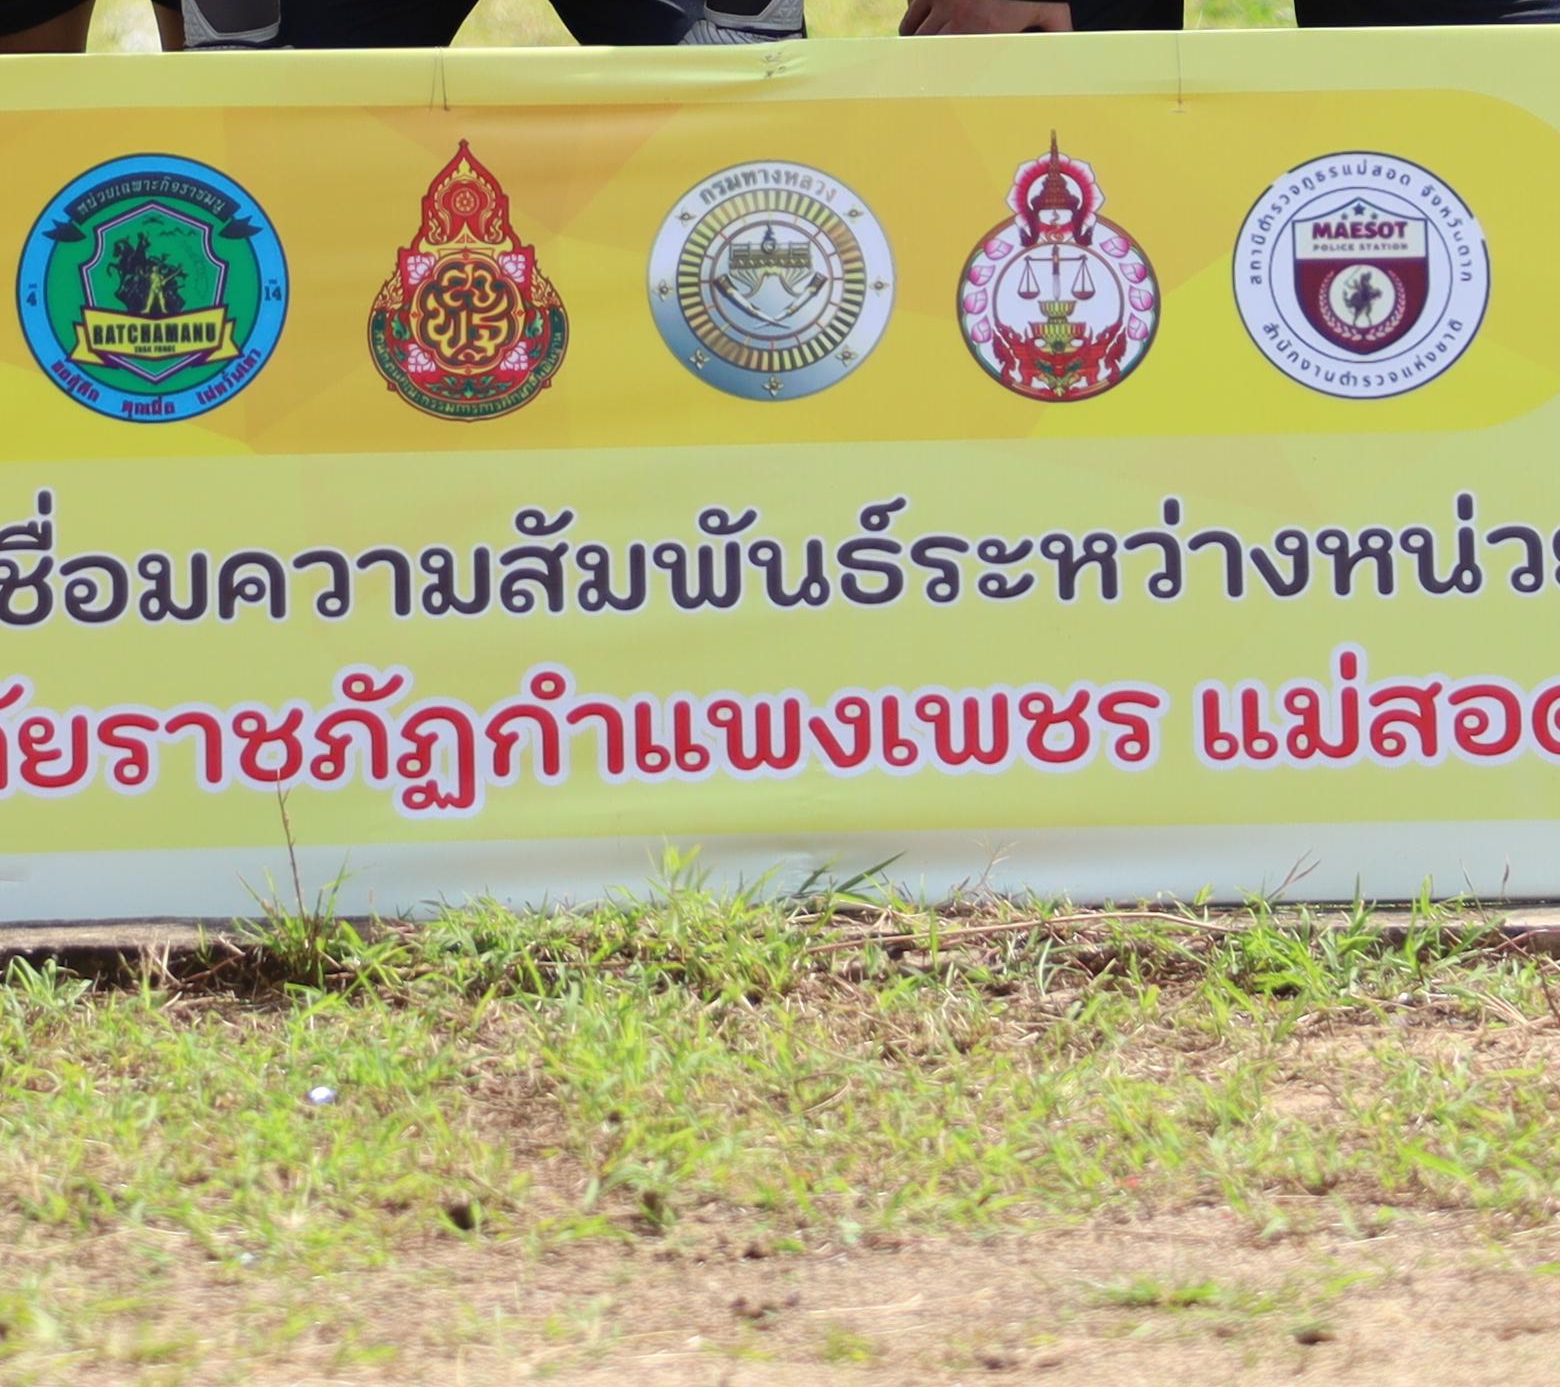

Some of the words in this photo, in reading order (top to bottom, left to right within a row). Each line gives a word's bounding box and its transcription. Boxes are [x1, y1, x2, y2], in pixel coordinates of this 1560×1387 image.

[700, 169, 837, 206] กรมทางหลวง
[1312, 221, 1408, 240] MAESOT
[1313, 243, 1355, 252] POLICE
[1359, 242, 1409, 251] STATION
